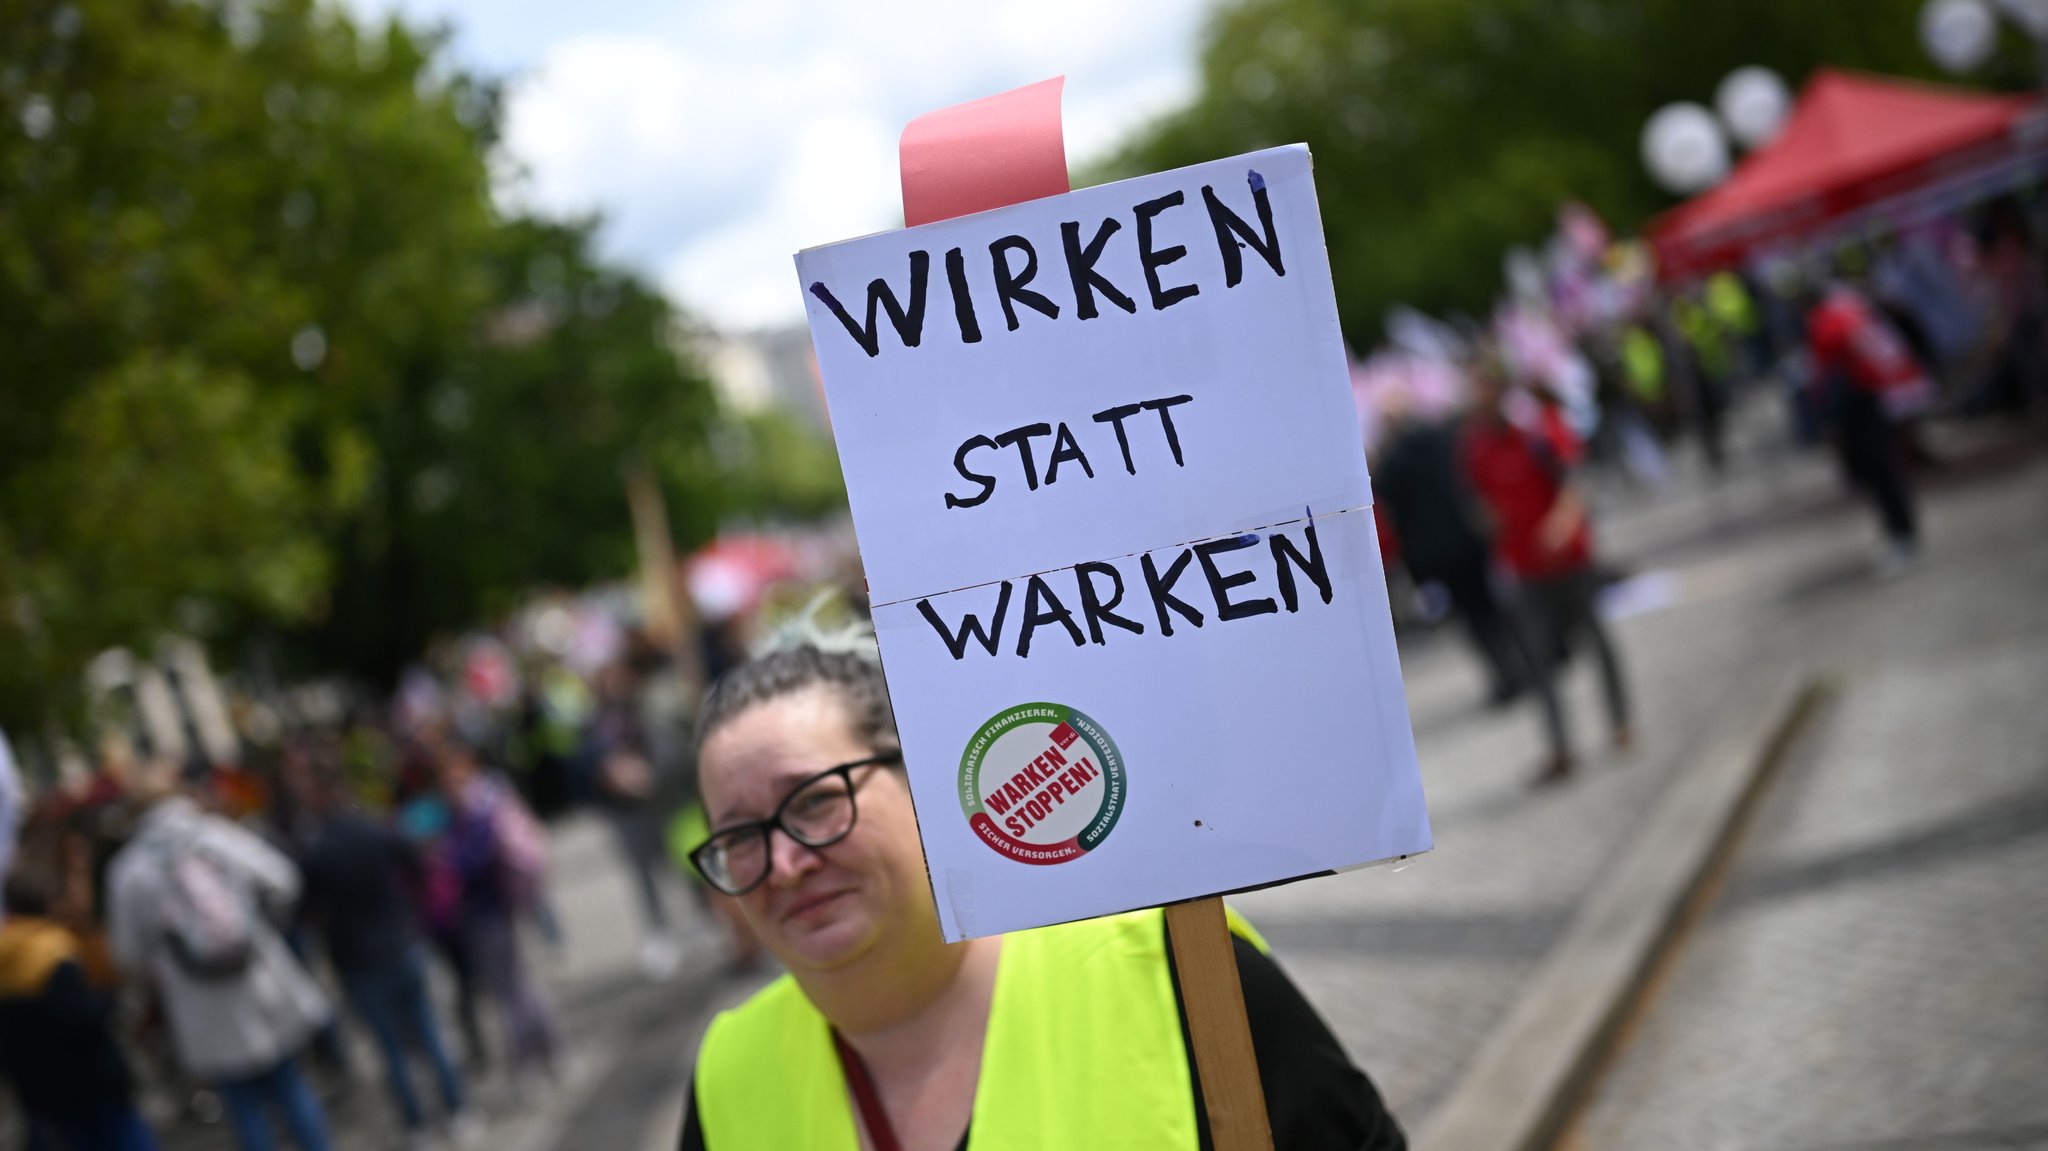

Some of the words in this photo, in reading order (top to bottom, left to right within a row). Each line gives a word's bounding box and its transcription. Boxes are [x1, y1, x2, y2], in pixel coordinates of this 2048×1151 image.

[810, 170, 1286, 358] WIRKEN
[945, 395, 1194, 509] STATT
[916, 506, 1333, 660] WARKEN
[964, 738, 988, 807] SOLIDARISCH
[985, 708, 1059, 738] FINANZIEREN.
[984, 745, 1068, 817] WARKEN
[1075, 716, 1120, 778] VERTEIDIGEN.
[1004, 756, 1100, 838] STOPPEN!
[1086, 780, 1120, 843] SOZIALSTAAT
[978, 822, 1011, 852] SICHER
[1012, 846, 1077, 860] VERSORGEN.
